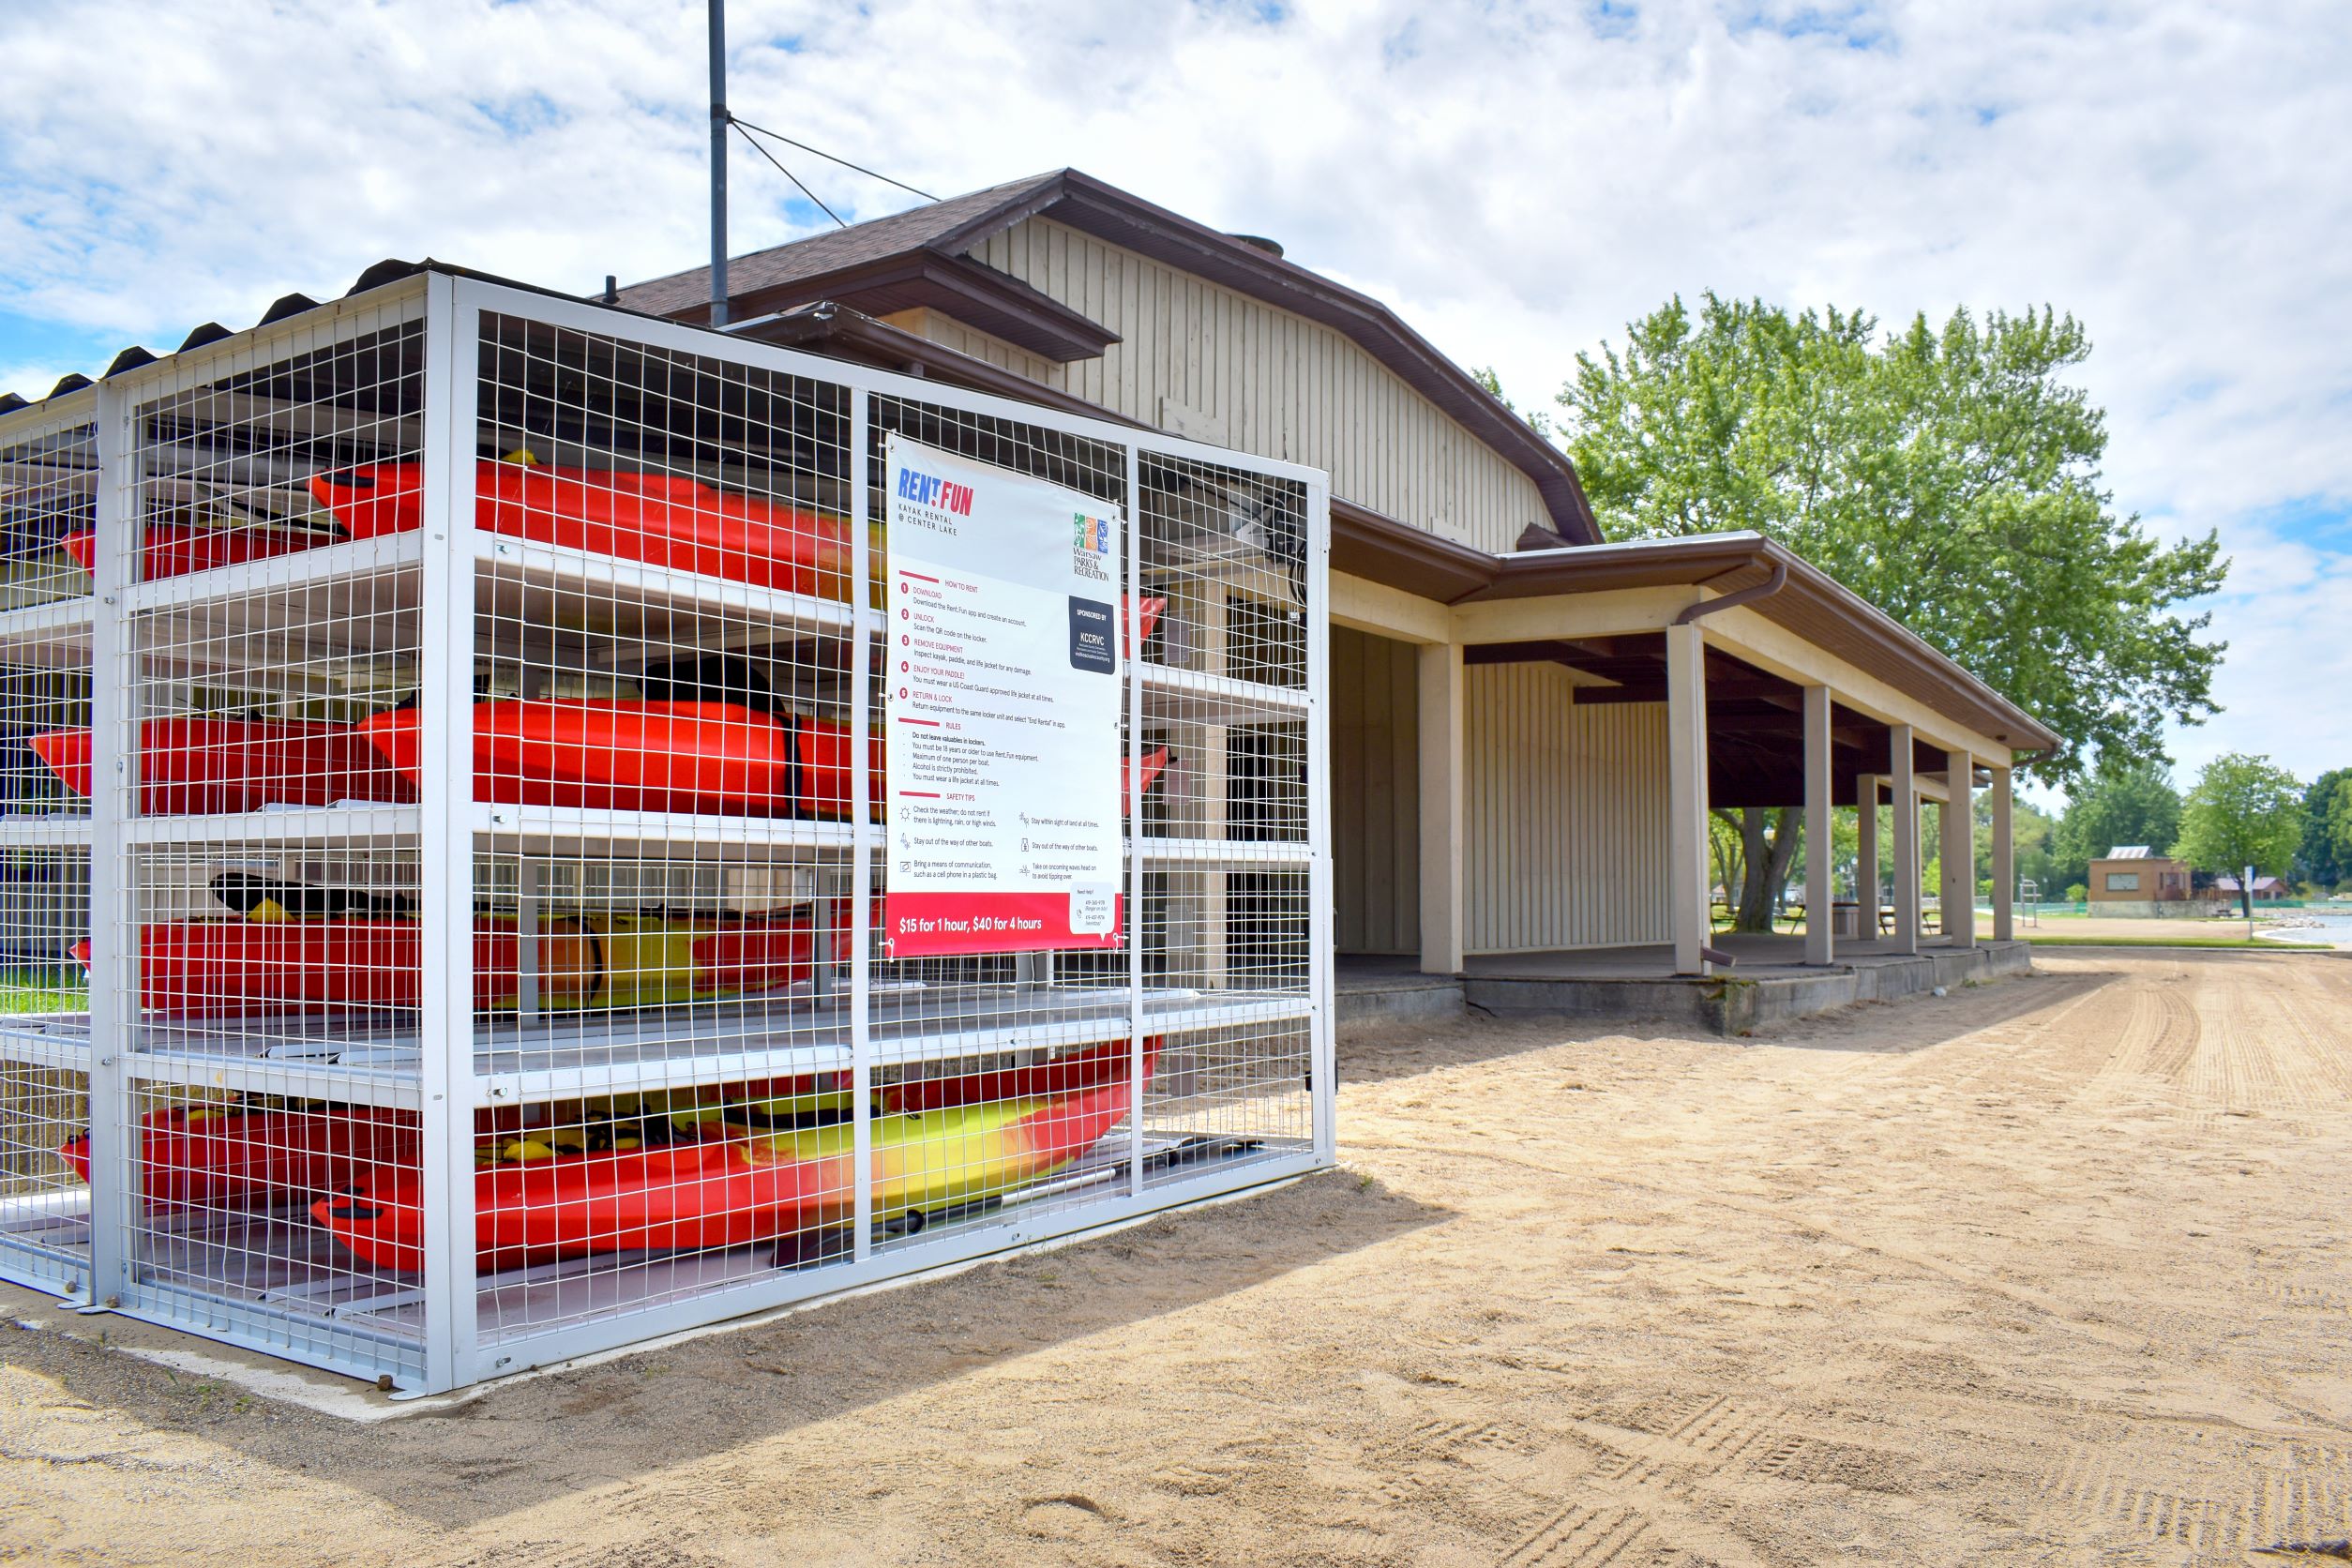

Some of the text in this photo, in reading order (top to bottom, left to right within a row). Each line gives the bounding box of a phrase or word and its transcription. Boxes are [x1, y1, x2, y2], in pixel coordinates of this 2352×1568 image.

[898, 467, 973, 517] RENT.FUN
[898, 503, 952, 525] KAYAK RENTAL
[898, 513, 957, 535] @ CENTER LAKE
[1073, 547, 1102, 561] Warsaw
[1074, 556, 1098, 570] PARKS &
[1074, 565, 1108, 581] RECREATION
[913, 587, 942, 598] DOWNLOAD
[945, 580, 978, 593] HOW TO RENT
[913, 597, 937, 609] Download
[947, 604, 967, 614] Rent.Fun
[914, 612, 934, 623] UNLOCK
[1077, 609, 1101, 620] SPONSORED
[914, 623, 926, 631] Scan
[972, 634, 988, 642] locker.
[1080, 632, 1105, 646] KCCRVC
[914, 639, 962, 654] REMOVE EQUIPMENT
[914, 649, 932, 659] Inspect
[933, 652, 948, 662] kayak,
[967, 657, 975, 666] and
[984, 661, 998, 670] jacket
[913, 665, 964, 679] ENJOY YOUR PADDLE!
[913, 675, 922, 684] You
[960, 682, 973, 690] Coast
[989, 687, 1010, 696] approved
[913, 691, 932, 700] RETURN
[912, 701, 928, 710] Return
[929, 705, 955, 714] equipment
[1015, 714, 1026, 723] select
[942, 735, 962, 744] valuables
[949, 746, 961, 755] years
[913, 752, 935, 761] Maximum
[953, 757, 968, 765] person
[936, 764, 953, 774] strictly
[972, 819, 981, 827] high
[913, 860, 927, 868] Bring
[1048, 872, 1063, 881] tipping
[899, 915, 1042, 934] $15 for 1 hour, $40 for 4 hours
